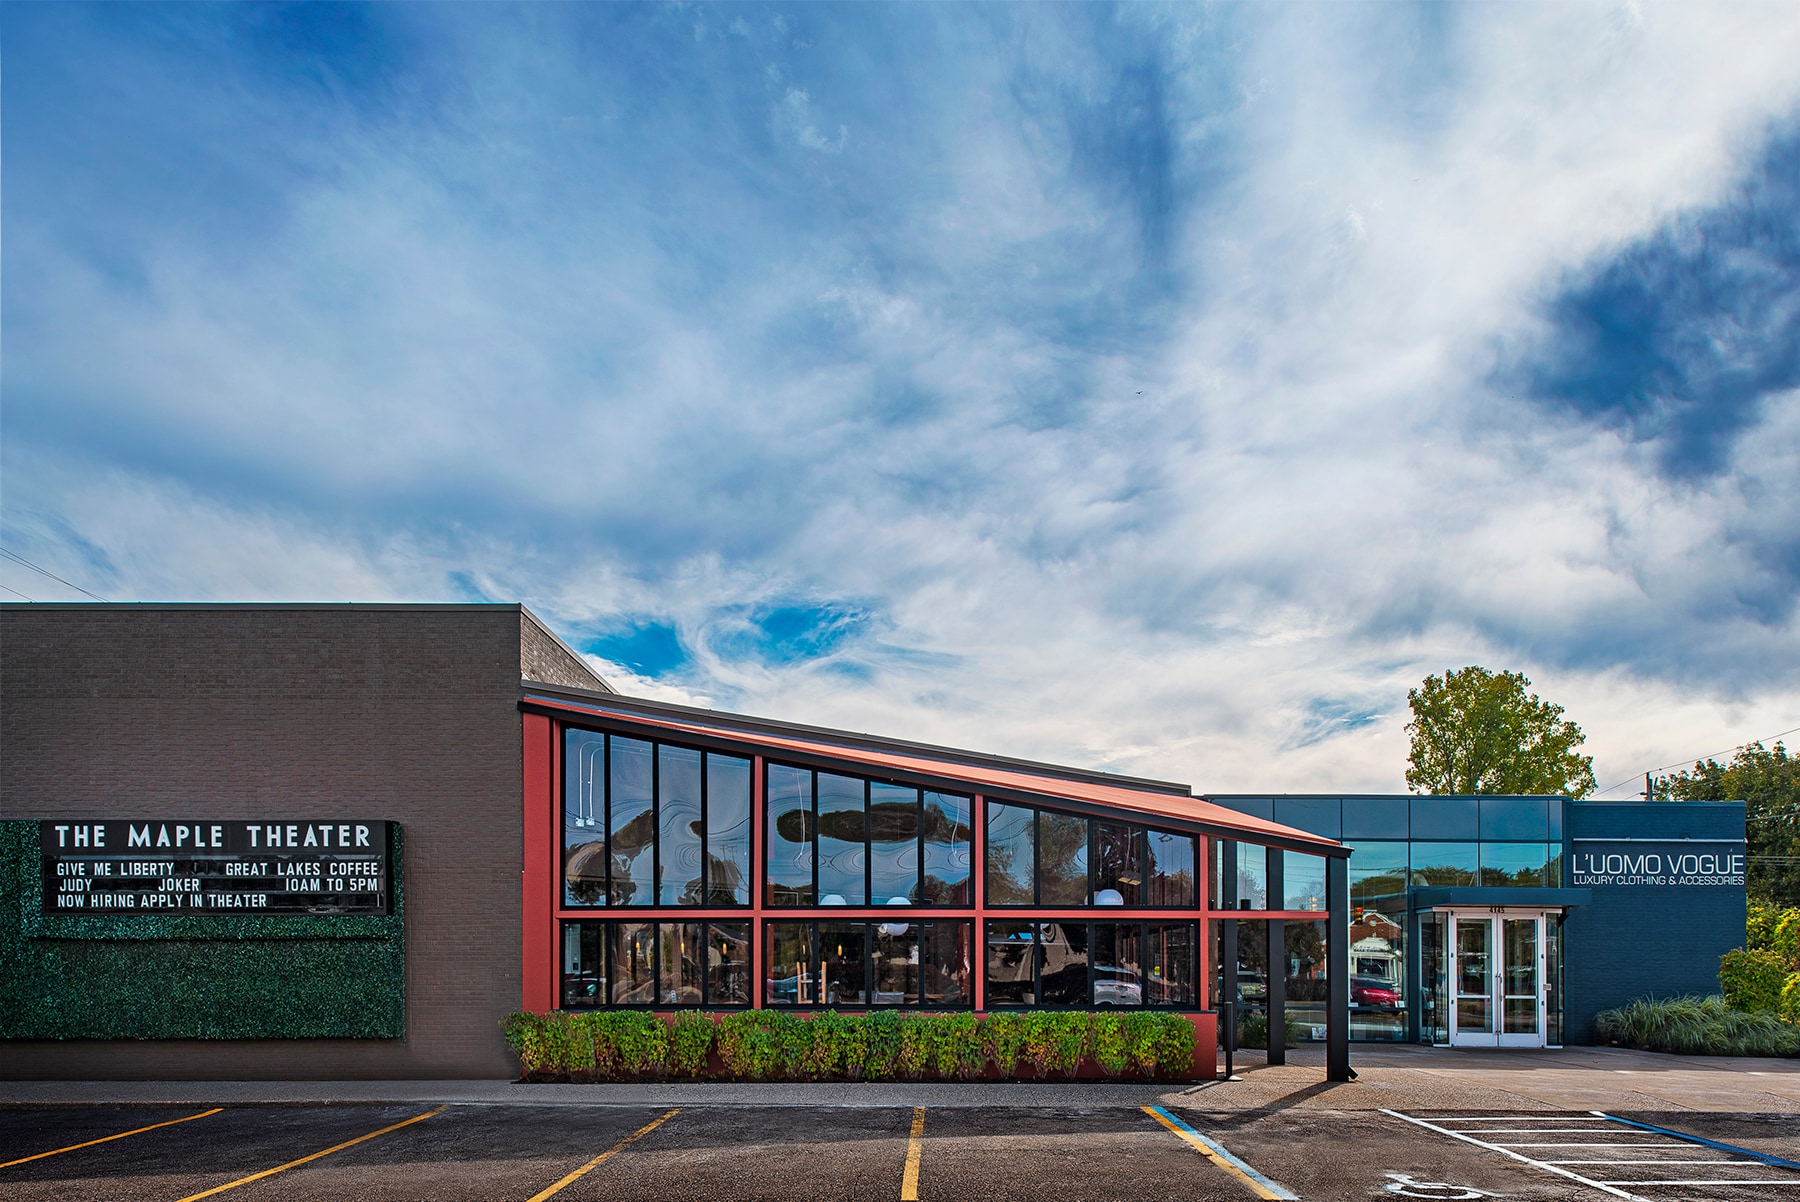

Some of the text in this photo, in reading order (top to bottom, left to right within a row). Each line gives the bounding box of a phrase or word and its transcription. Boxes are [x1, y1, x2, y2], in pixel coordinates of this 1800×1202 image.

[55, 824, 370, 847] THE MAPLE THEATER
[57, 862, 174, 876] GIVE ME LIBERTY
[225, 862, 378, 876] GREAT LAKES COFFEE
[1667, 854, 1745, 875] VOGUE
[59, 878, 92, 892] JUDY
[158, 878, 200, 892] JOKER
[327, 878, 343, 892] TO
[349, 878, 378, 892] 5PM
[1573, 875, 1745, 886] LUXURY CLOTHING & ACCESSORIES
[57, 894, 267, 908] NOW HIRING APPLY IN THEATER
